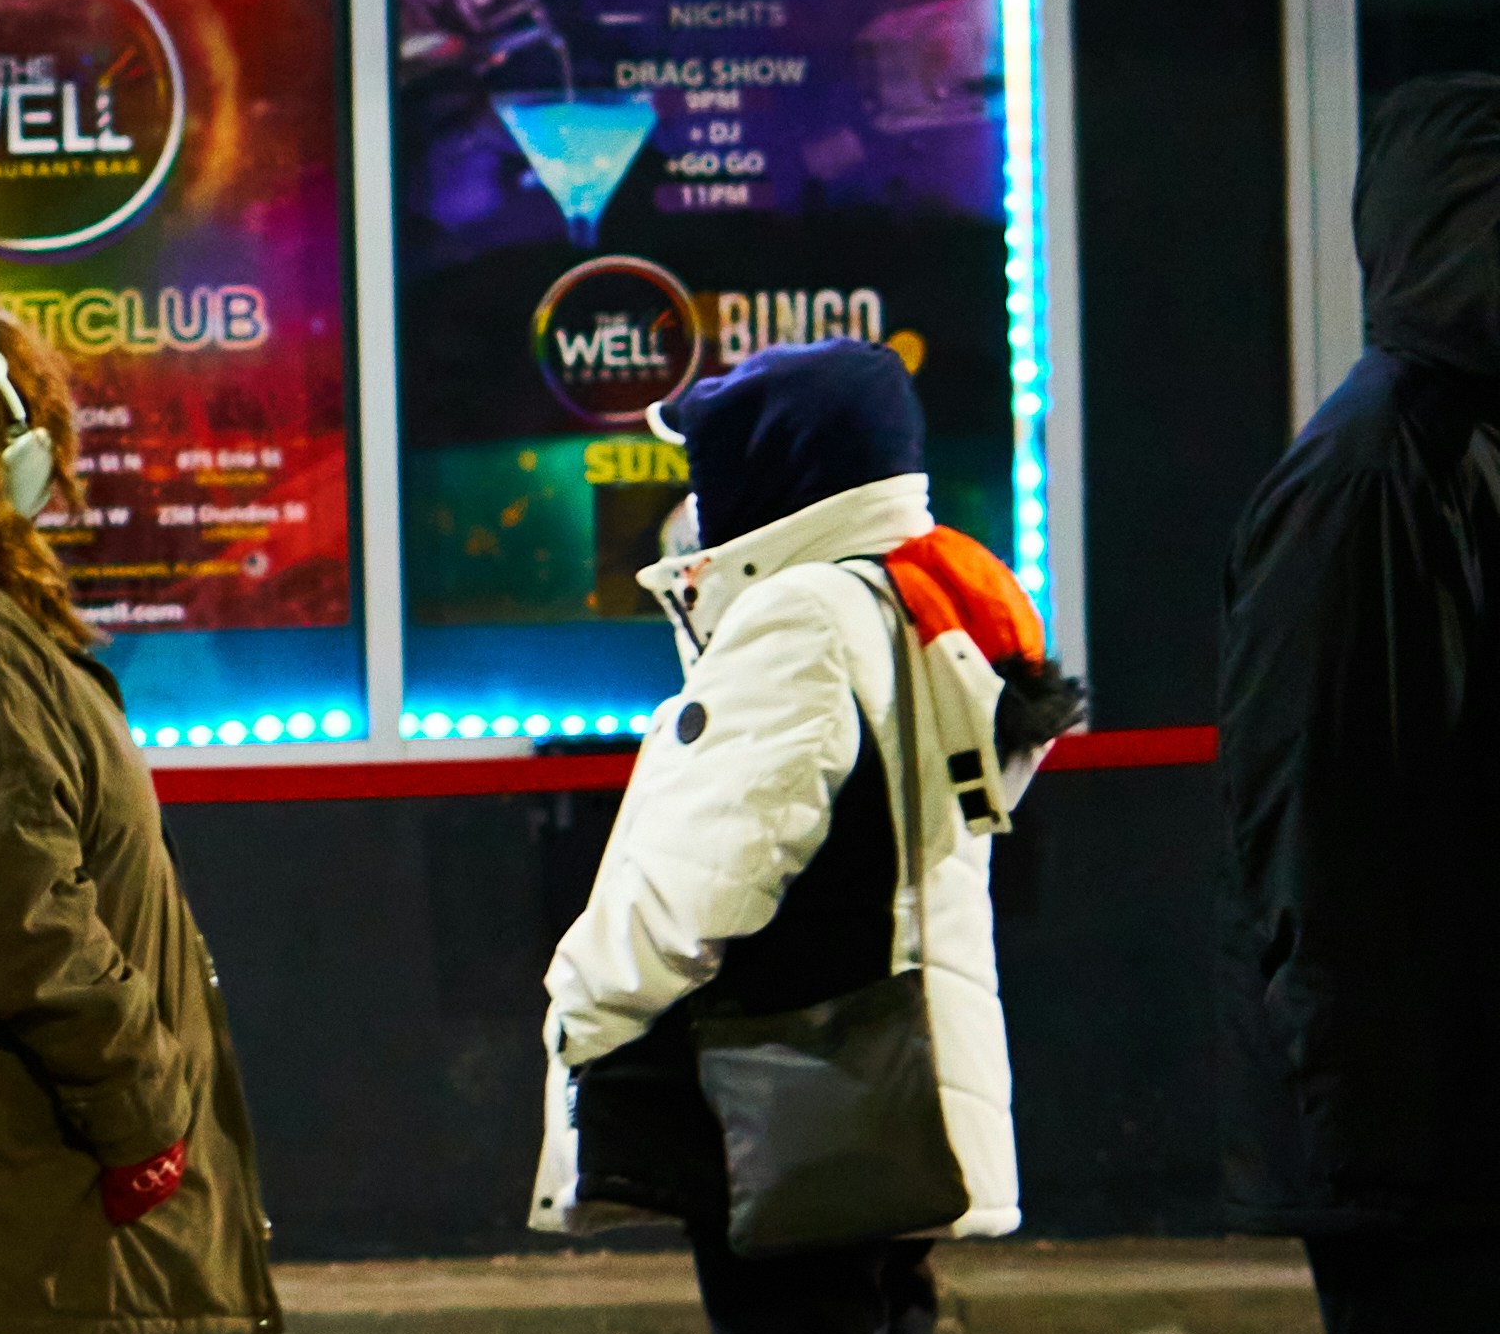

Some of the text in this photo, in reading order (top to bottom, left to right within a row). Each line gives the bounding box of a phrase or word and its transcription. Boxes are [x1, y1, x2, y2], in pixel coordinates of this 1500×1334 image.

[668, 0, 787, 28] NIGHTS
[615, 56, 808, 87] DRAG SHOW
[708, 121, 741, 144] DJ
[717, 287, 882, 365] BINGO
[555, 327, 667, 367] WELL
